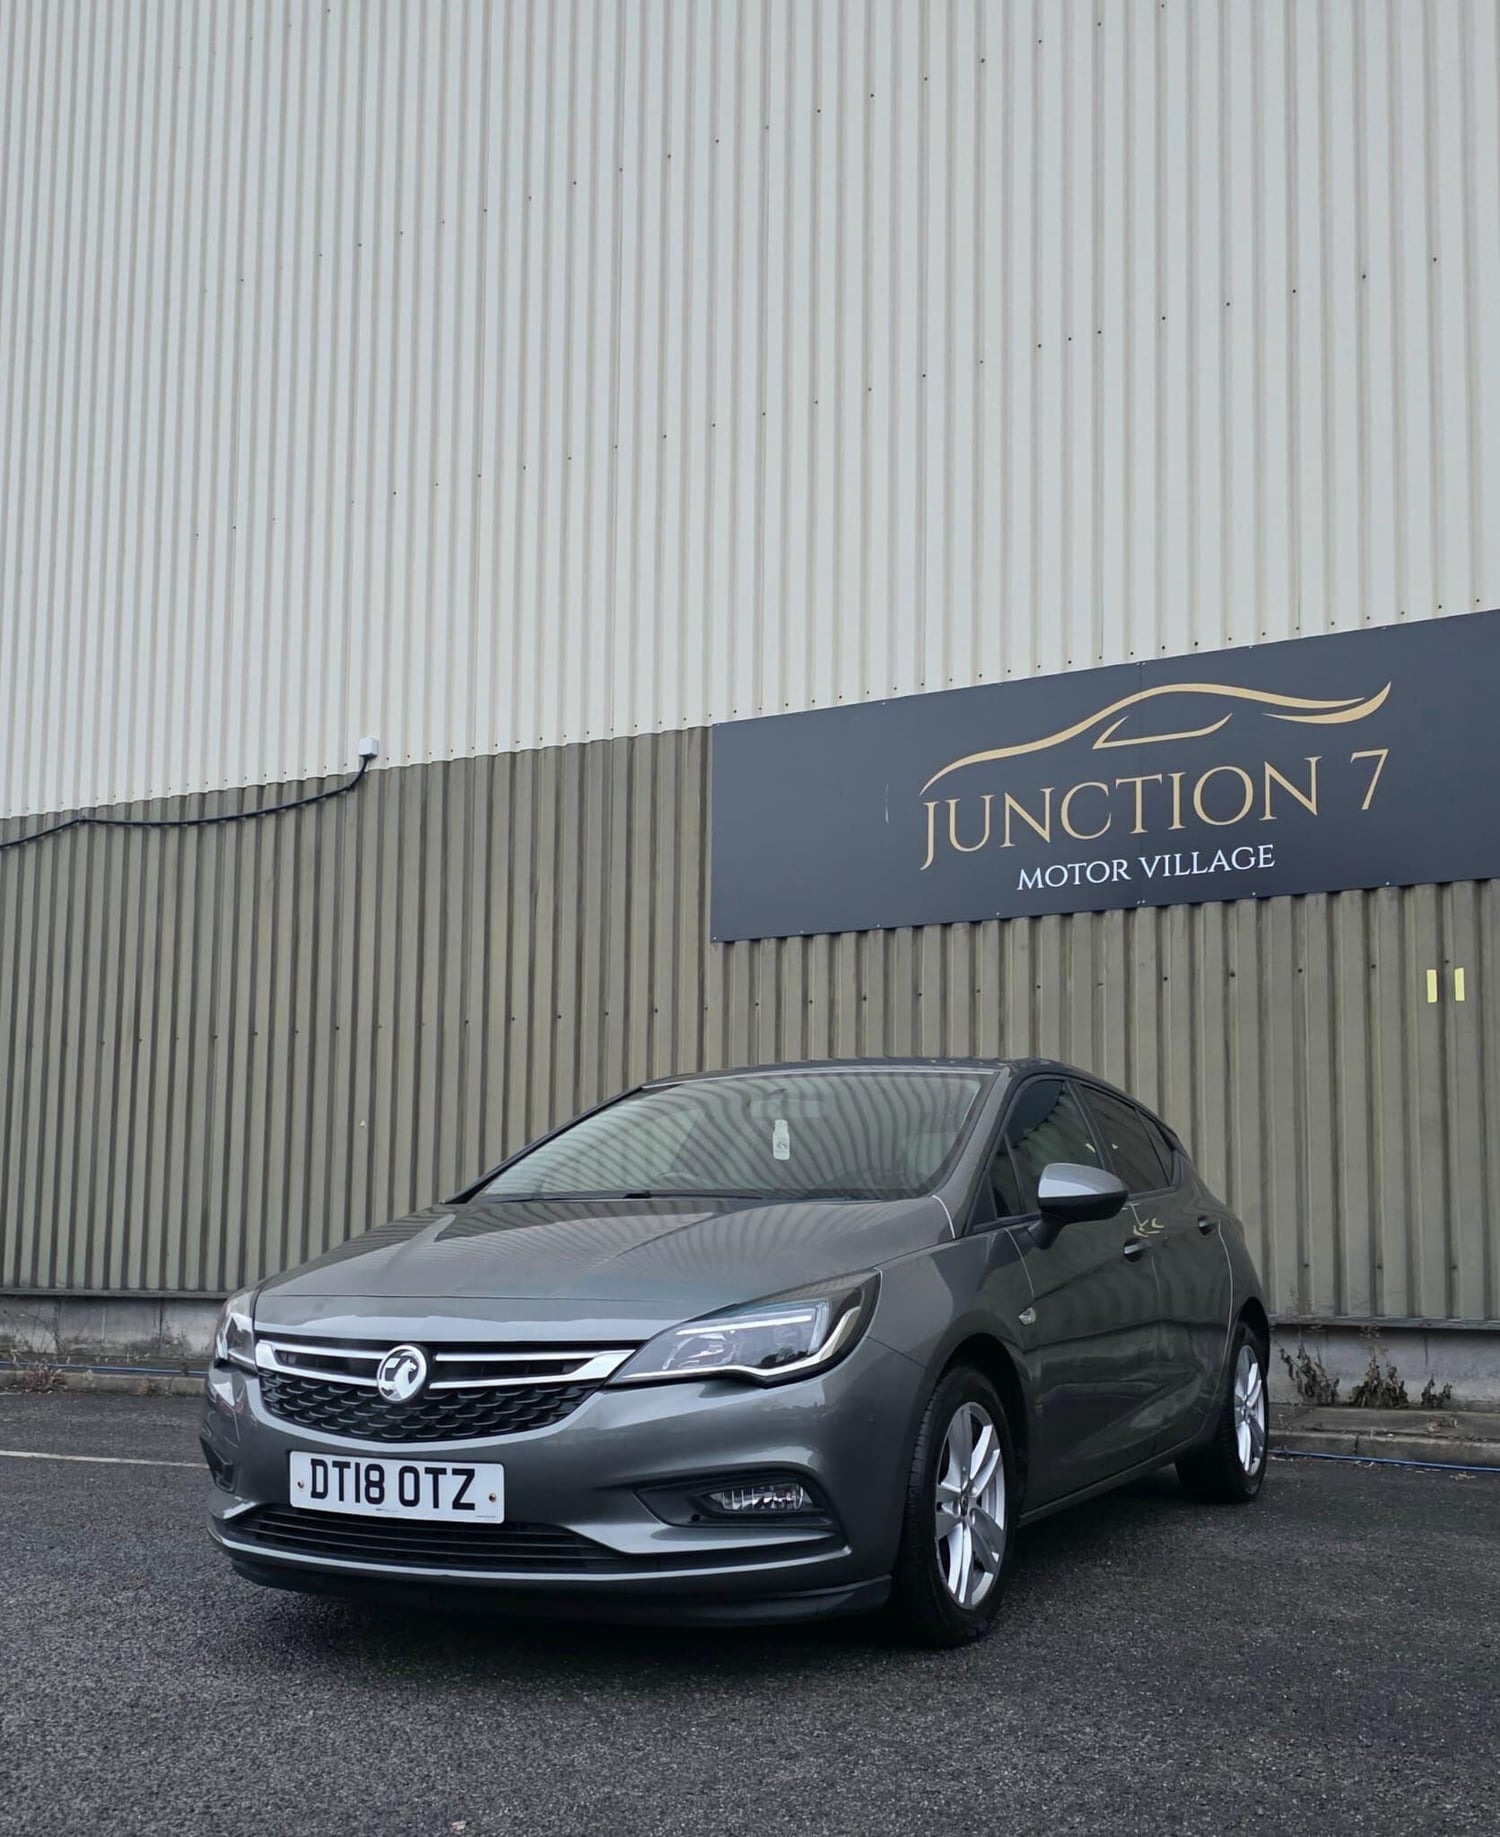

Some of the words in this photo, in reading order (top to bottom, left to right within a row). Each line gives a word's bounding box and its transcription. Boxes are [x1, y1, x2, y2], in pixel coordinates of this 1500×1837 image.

[920, 756, 1322, 870] JUNCTION
[1350, 749, 1390, 811] 7
[1017, 857, 1132, 891] MOTOR
[1138, 844, 1276, 879] VILLAGE
[310, 1458, 385, 1505] DT18
[398, 1465, 476, 1511] OTZ
